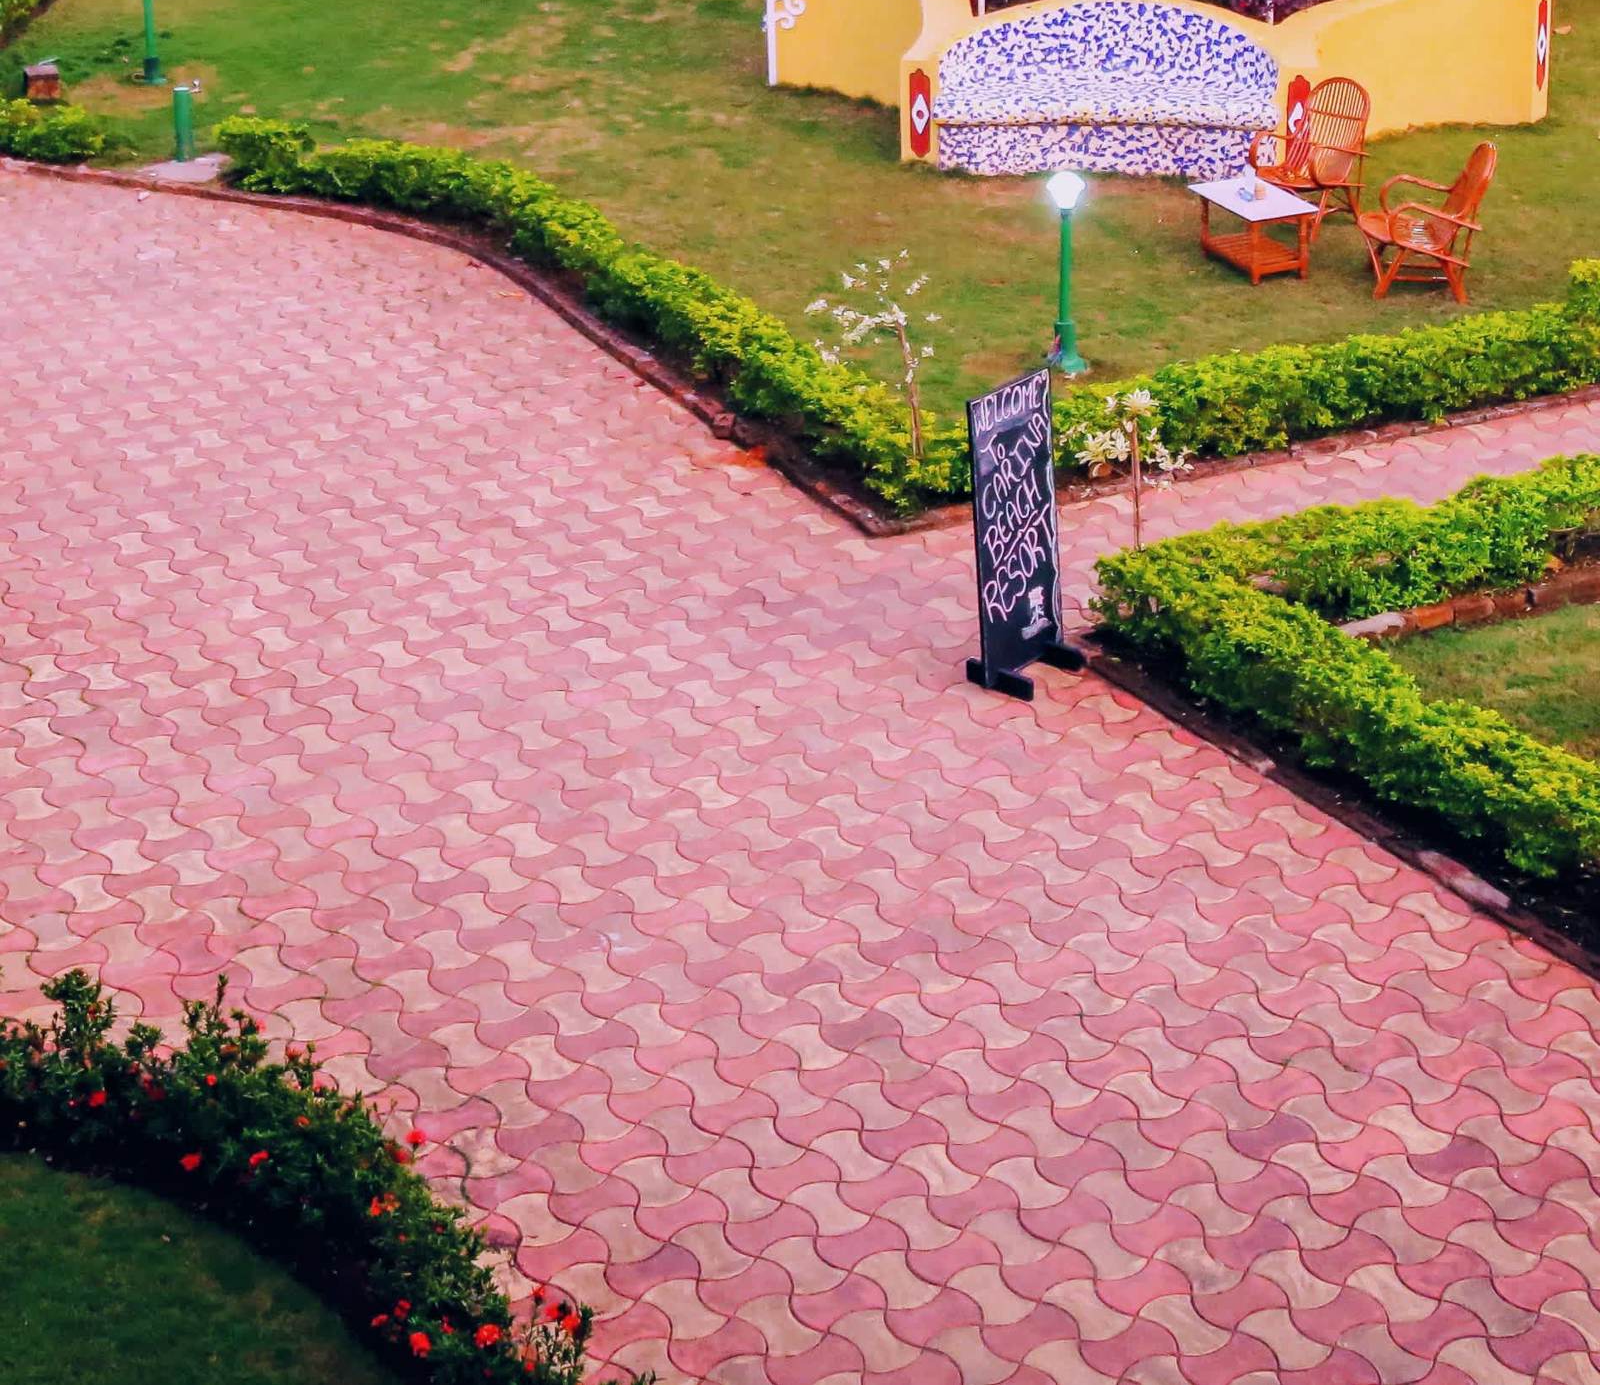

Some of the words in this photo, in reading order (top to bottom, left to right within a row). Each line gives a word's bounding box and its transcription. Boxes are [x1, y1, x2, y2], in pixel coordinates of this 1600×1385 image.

[973, 375, 1042, 437] WELCOME
[982, 412, 1048, 519] CARINA
[983, 468, 1042, 568] BEACH
[983, 503, 1053, 623] RESORT
